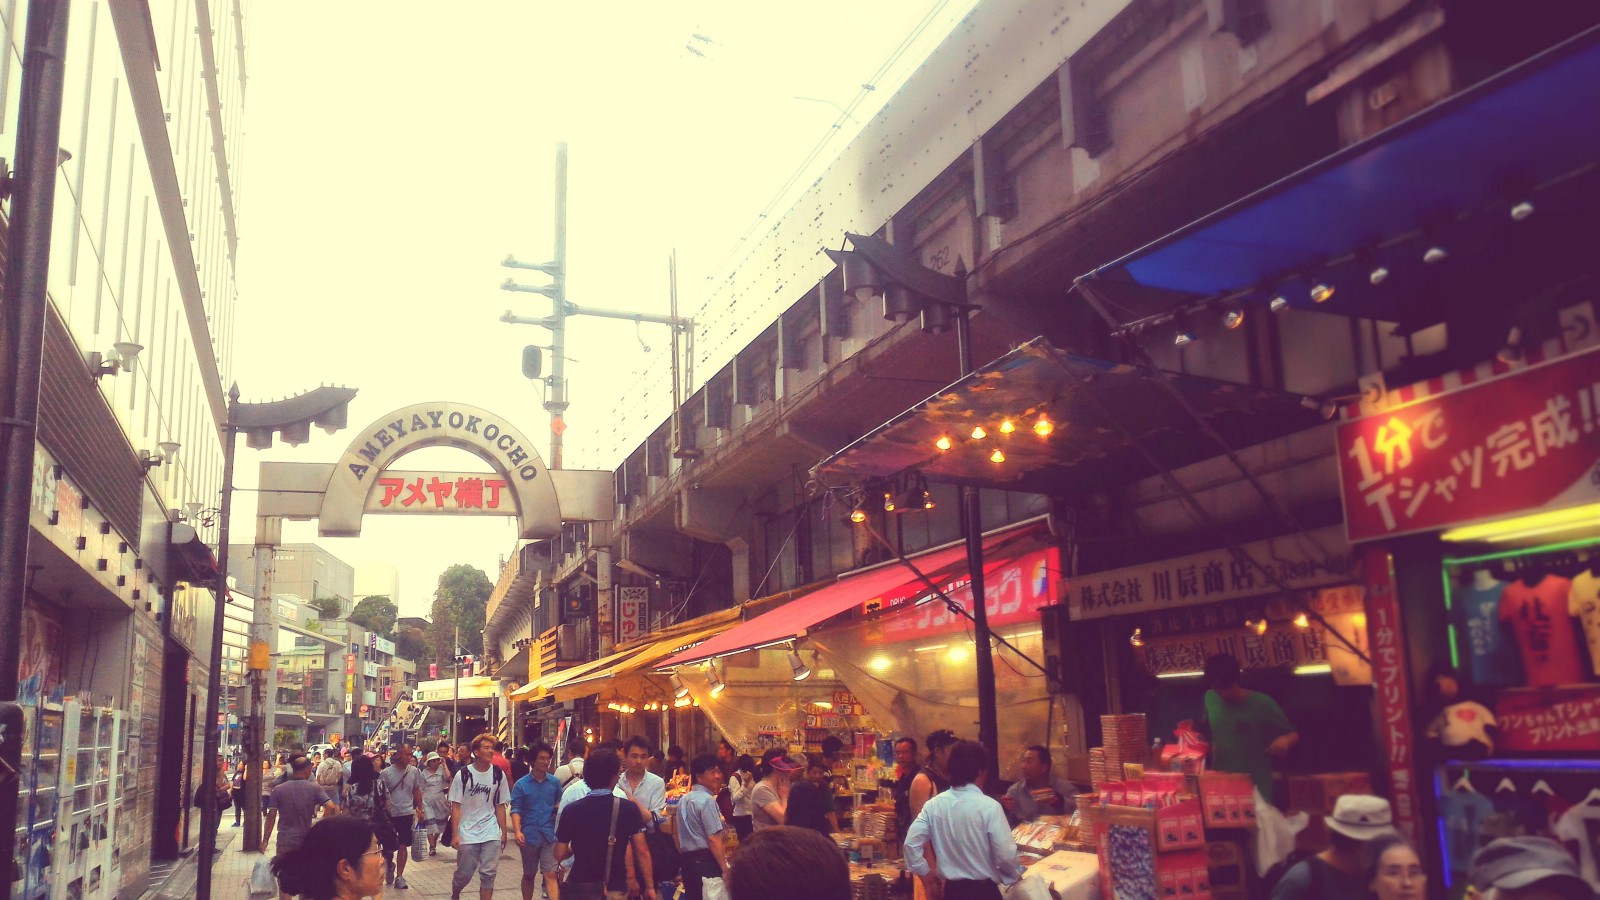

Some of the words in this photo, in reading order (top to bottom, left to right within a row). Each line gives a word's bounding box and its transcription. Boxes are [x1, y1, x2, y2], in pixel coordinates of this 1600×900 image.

[348, 410, 538, 481] AMEYAYOKOCHO
[1348, 407, 1448, 492] 1分で
[378, 476, 507, 509] アメヤ横丁
[1080, 577, 1144, 611] 株式会社
[1152, 558, 1255, 601] 川辰商店
[1375, 608, 1408, 763] 1分でプリント!!
